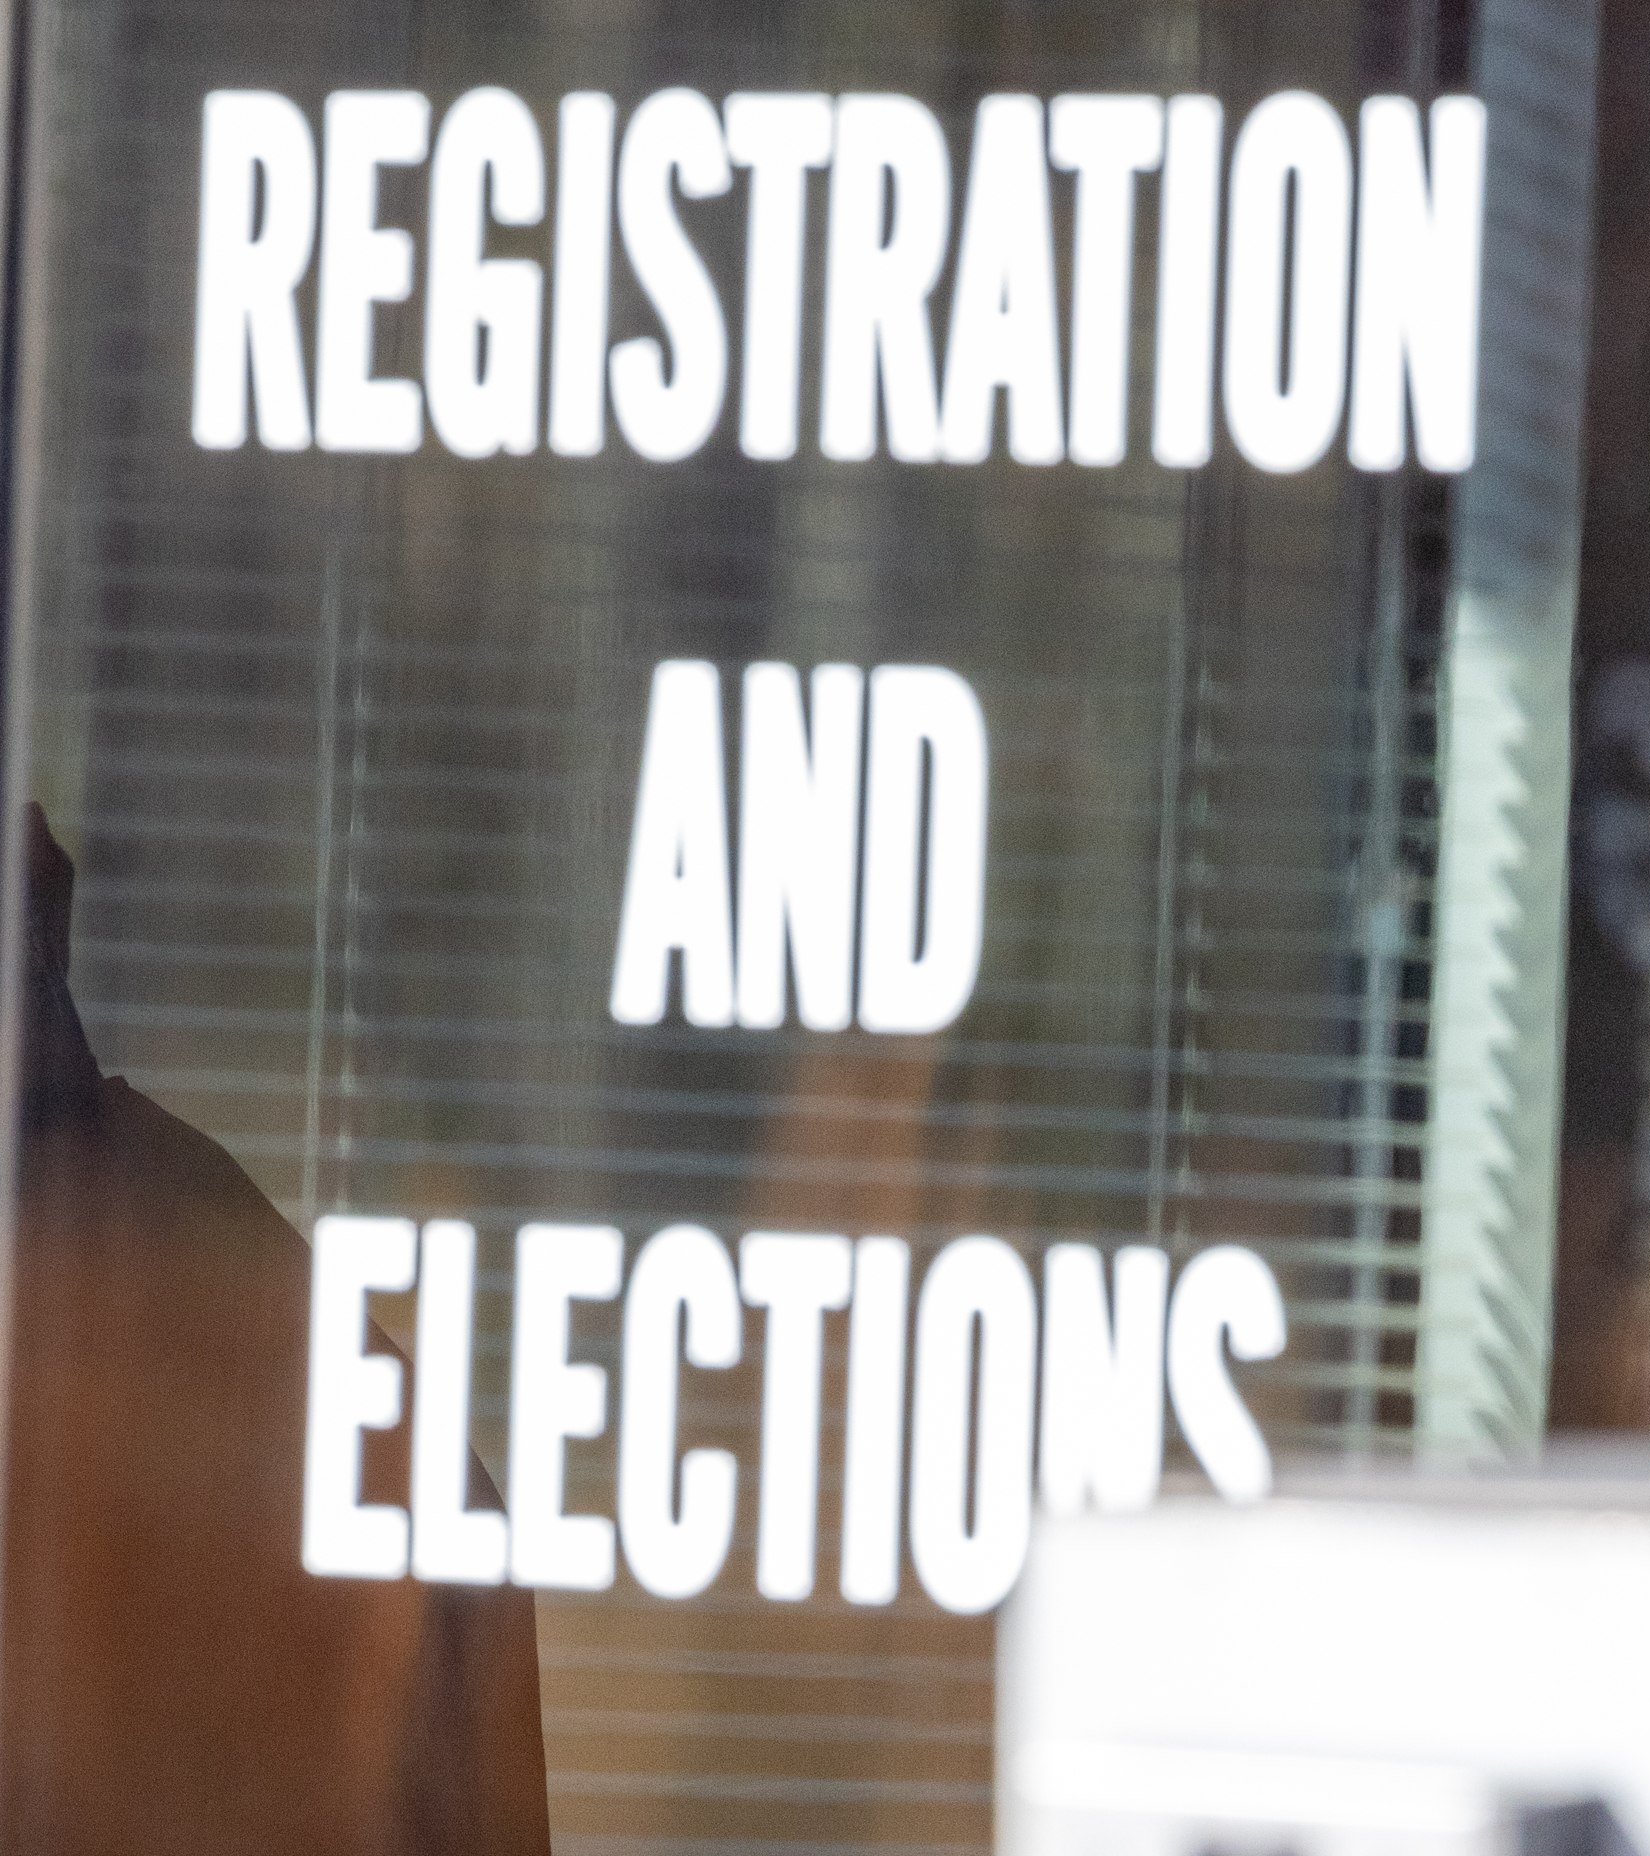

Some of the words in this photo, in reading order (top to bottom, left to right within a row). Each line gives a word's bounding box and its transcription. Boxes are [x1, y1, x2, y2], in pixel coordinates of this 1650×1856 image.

[191, 87, 1487, 473] REGISTRATION
[609, 660, 988, 1034] AND
[301, 1215, 1287, 1614] ELECTIONS
